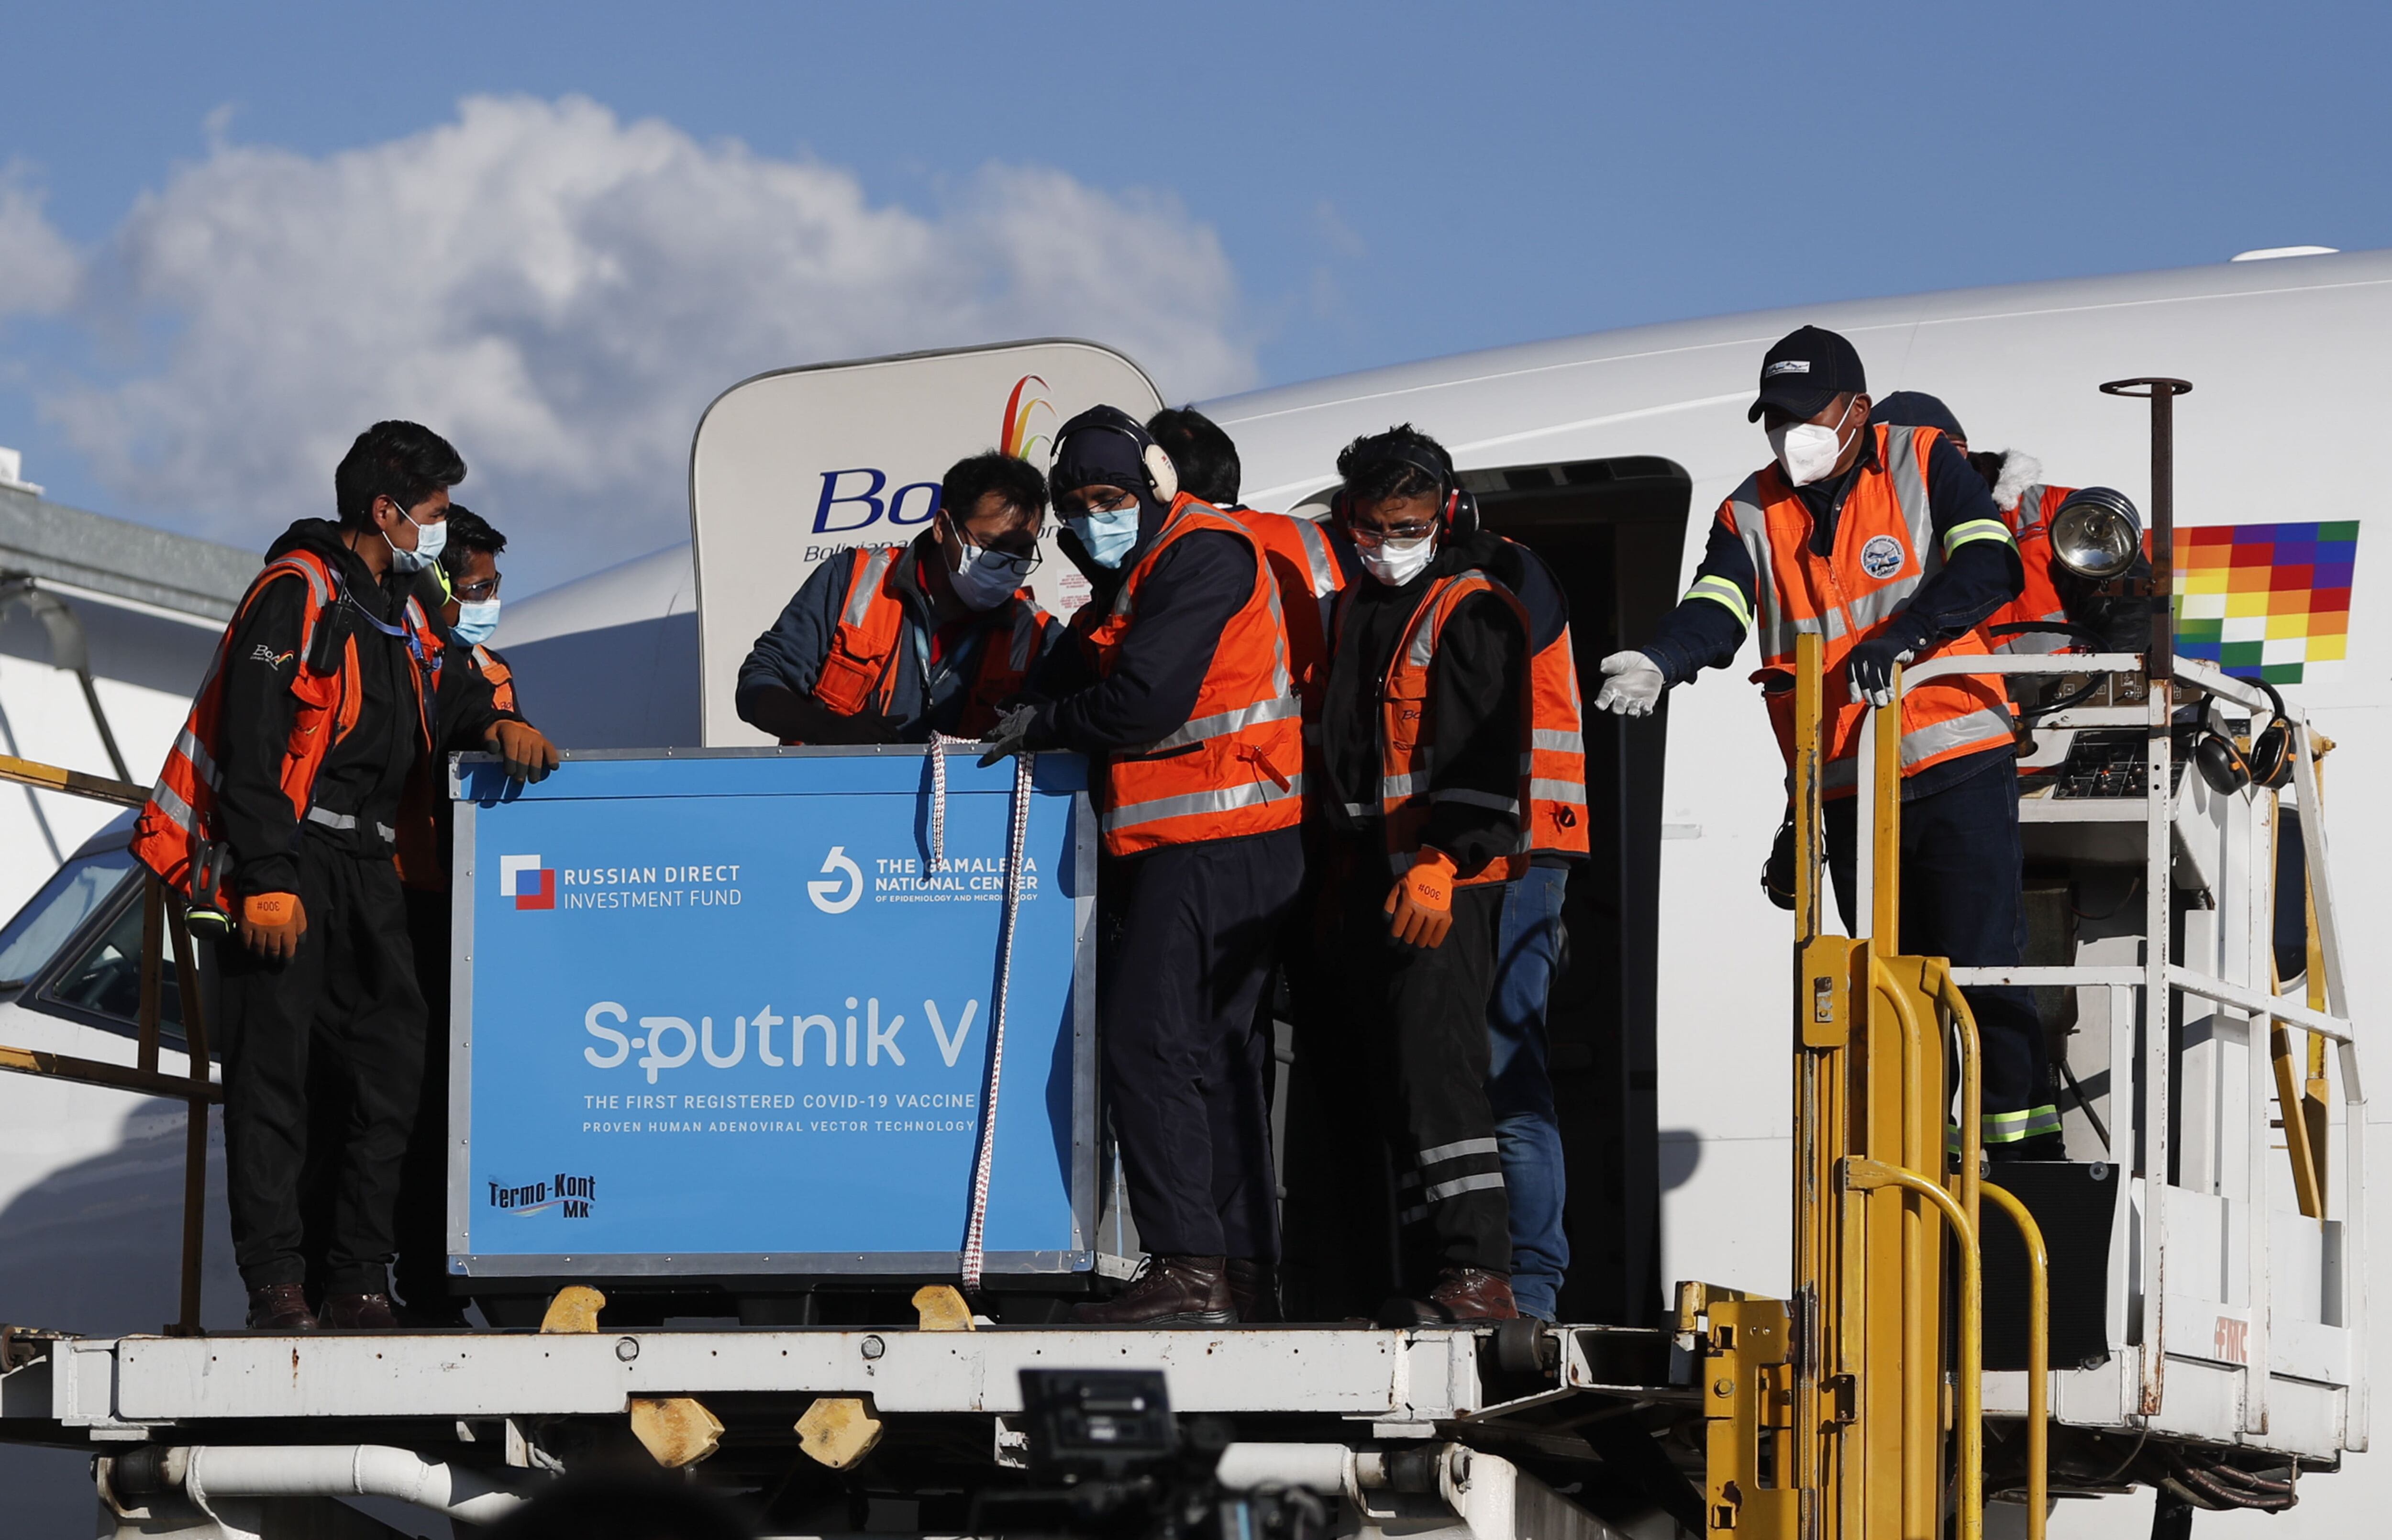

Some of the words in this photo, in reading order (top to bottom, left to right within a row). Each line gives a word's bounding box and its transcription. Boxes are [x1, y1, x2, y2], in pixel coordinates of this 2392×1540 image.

[812, 467, 941, 534] Bo
[876, 859, 916, 874] THE
[925, 857, 1037, 873] GAMALEA
[565, 867, 656, 885] RUSSIAN
[665, 865, 740, 883] DIRECT
[875, 877, 965, 891] NATIONAL
[970, 876, 1038, 890] CENER
[565, 890, 683, 908] INVESTMENT
[691, 889, 741, 906] FUND
[974, 893, 1038, 901] MICROBOGY
[584, 997, 906, 1084] Sputnik
[924, 999, 978, 1067] V
[584, 1096, 619, 1109] THE
[627, 1096, 677, 1109] FIRST
[685, 1095, 795, 1108] REGISTERED
[803, 1095, 887, 1108] COVID-19
[896, 1094, 975, 1108] VACCINE
[583, 1122, 641, 1132] PROVEN
[649, 1122, 701, 1132] HUMAN
[709, 1121, 803, 1132] ADENOVIRAL
[811, 1121, 867, 1131] VECTOR
[875, 1121, 974, 1131] TECHNOLOGY
[488, 1173, 596, 1208] Termo-Kont
